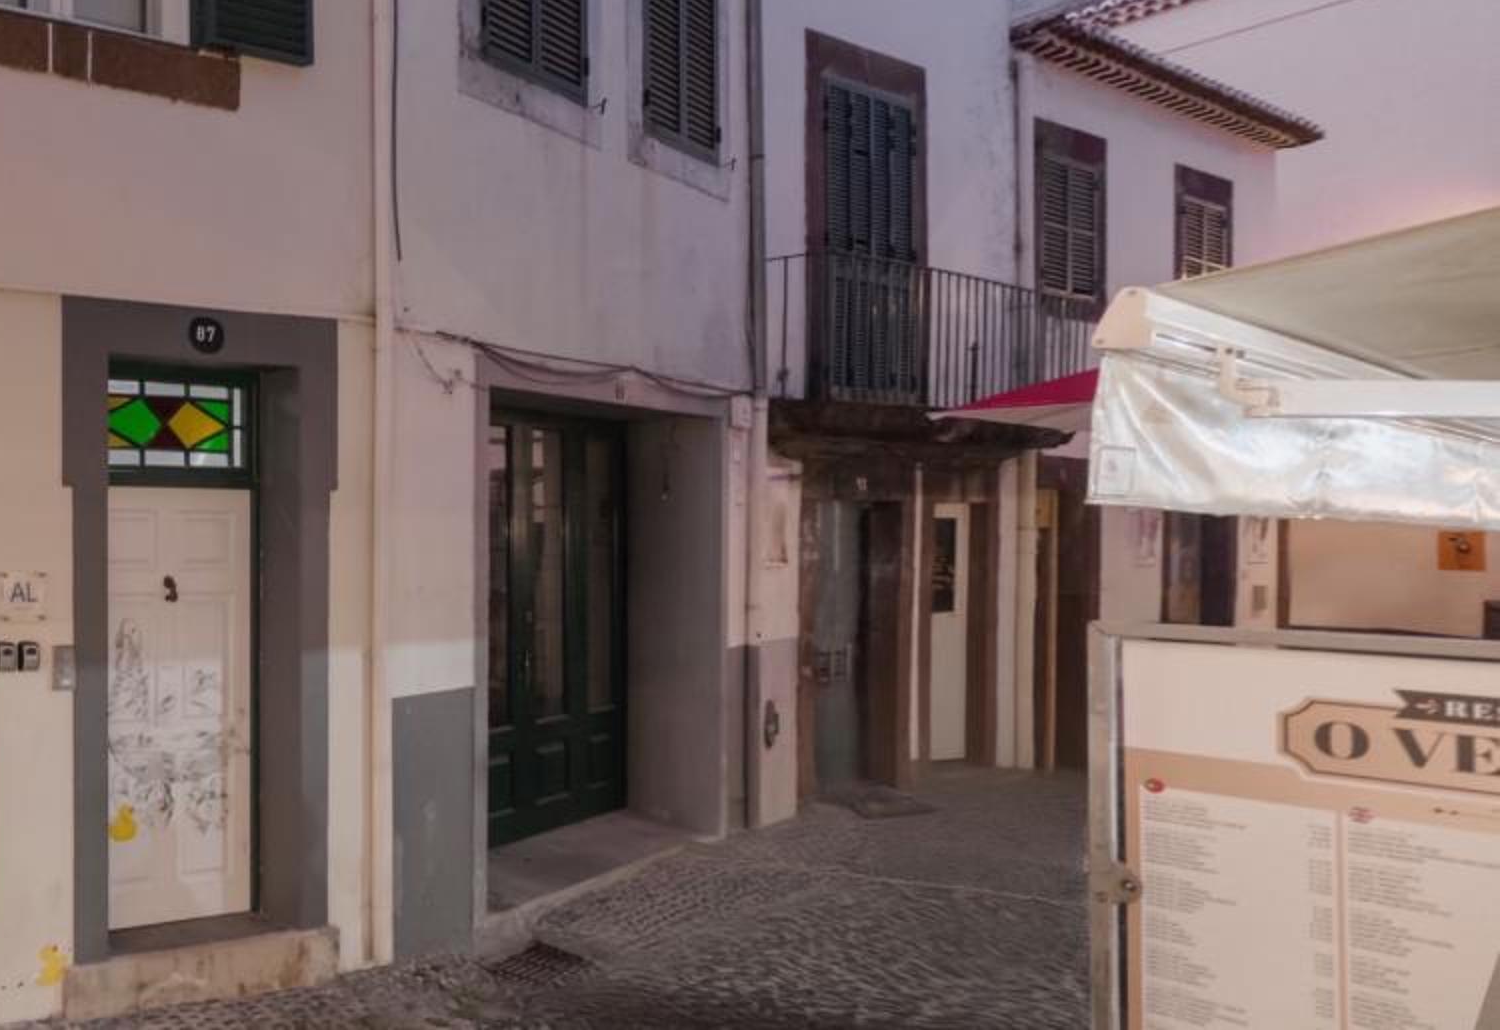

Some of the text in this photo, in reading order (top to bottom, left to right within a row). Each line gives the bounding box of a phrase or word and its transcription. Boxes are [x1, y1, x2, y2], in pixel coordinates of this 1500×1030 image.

[197, 326, 215, 342] 87
[10, 582, 38, 602] AL
[1315, 721, 1369, 760] O
